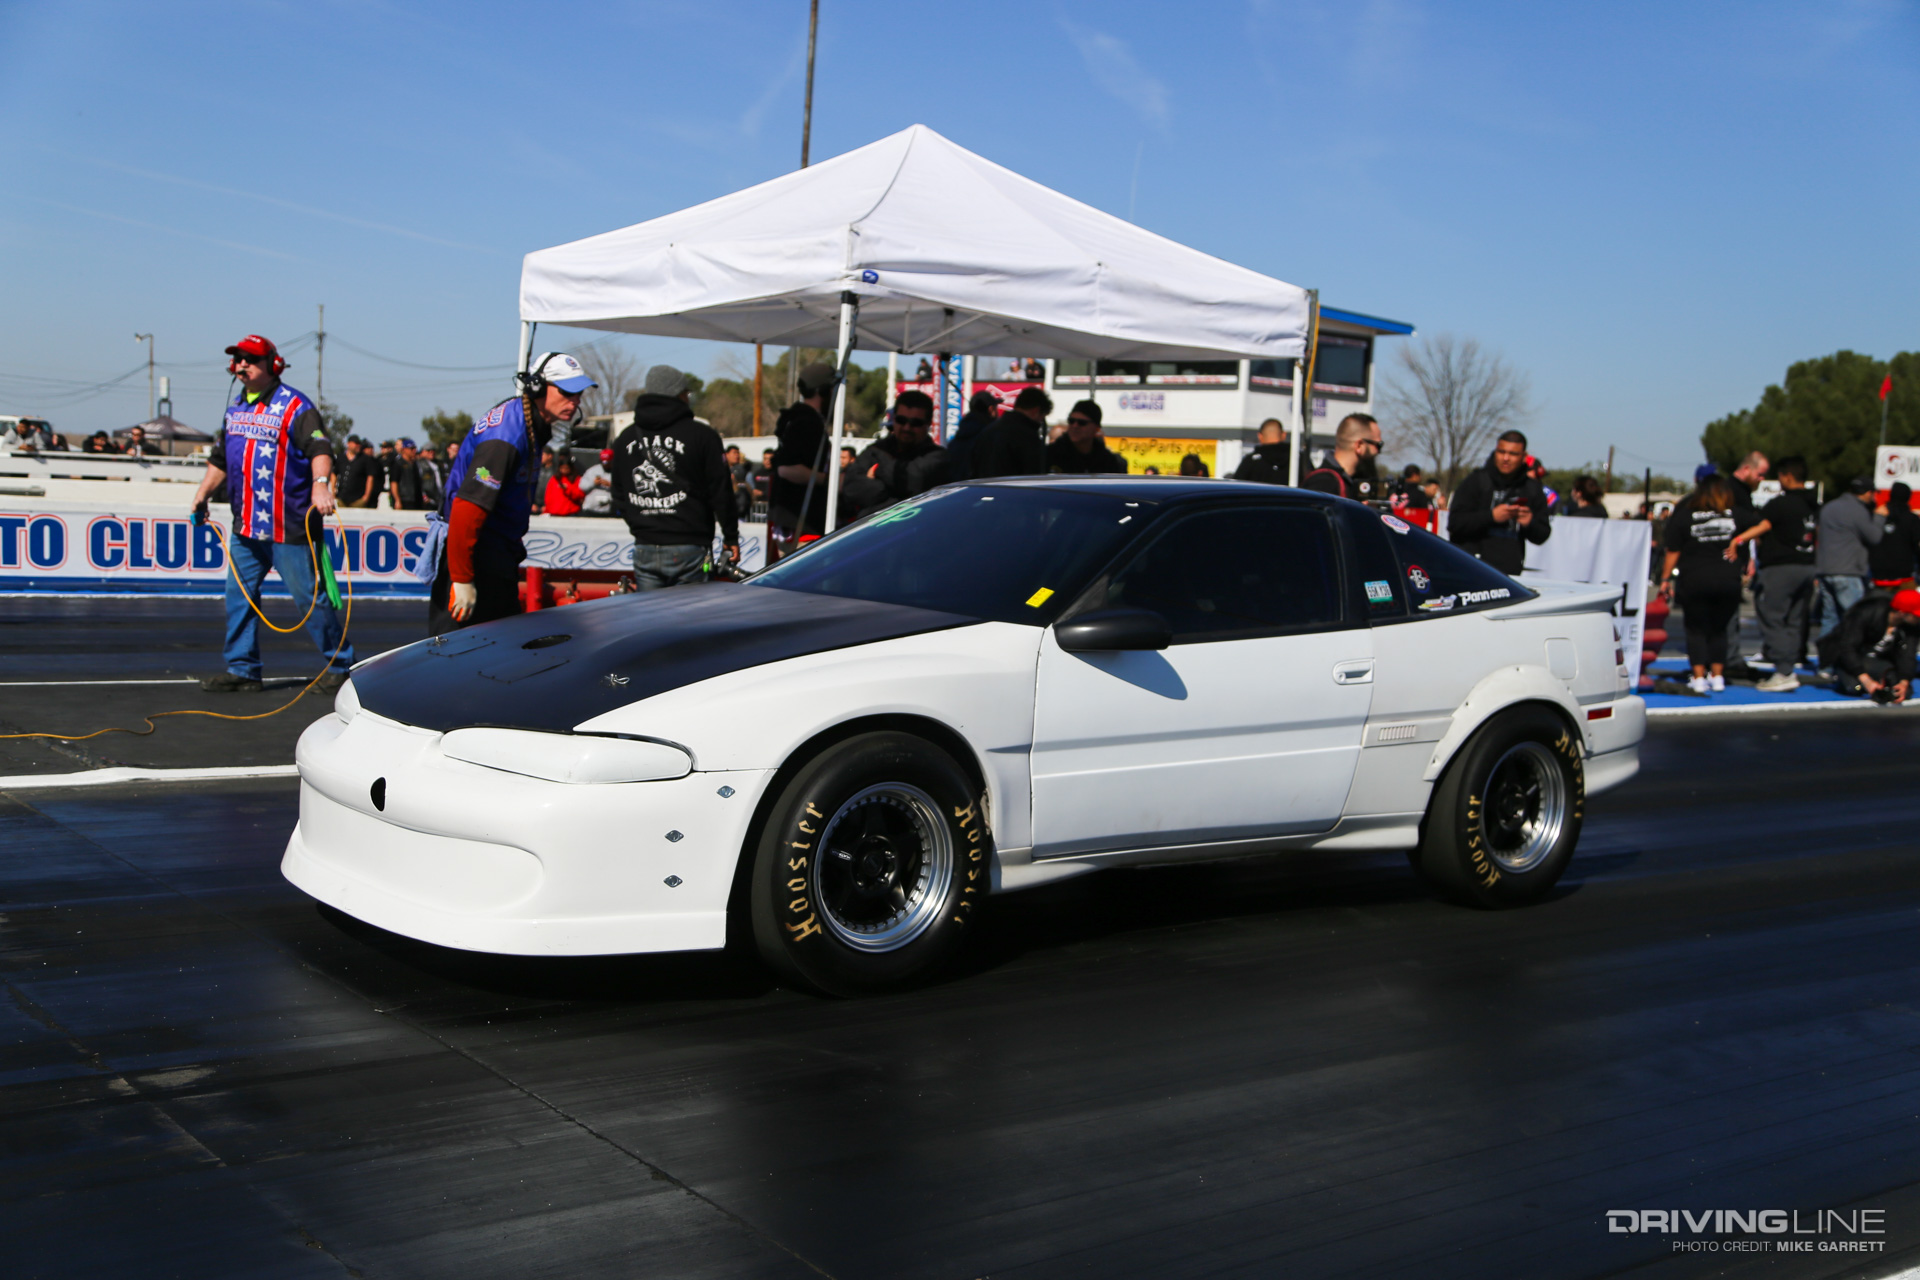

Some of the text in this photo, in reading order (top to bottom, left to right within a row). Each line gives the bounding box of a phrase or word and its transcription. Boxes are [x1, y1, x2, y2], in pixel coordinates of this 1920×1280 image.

[628, 490, 687, 508] HOOKERS
[87, 516, 227, 572] CLUB
[786, 802, 823, 942] Hoosier
